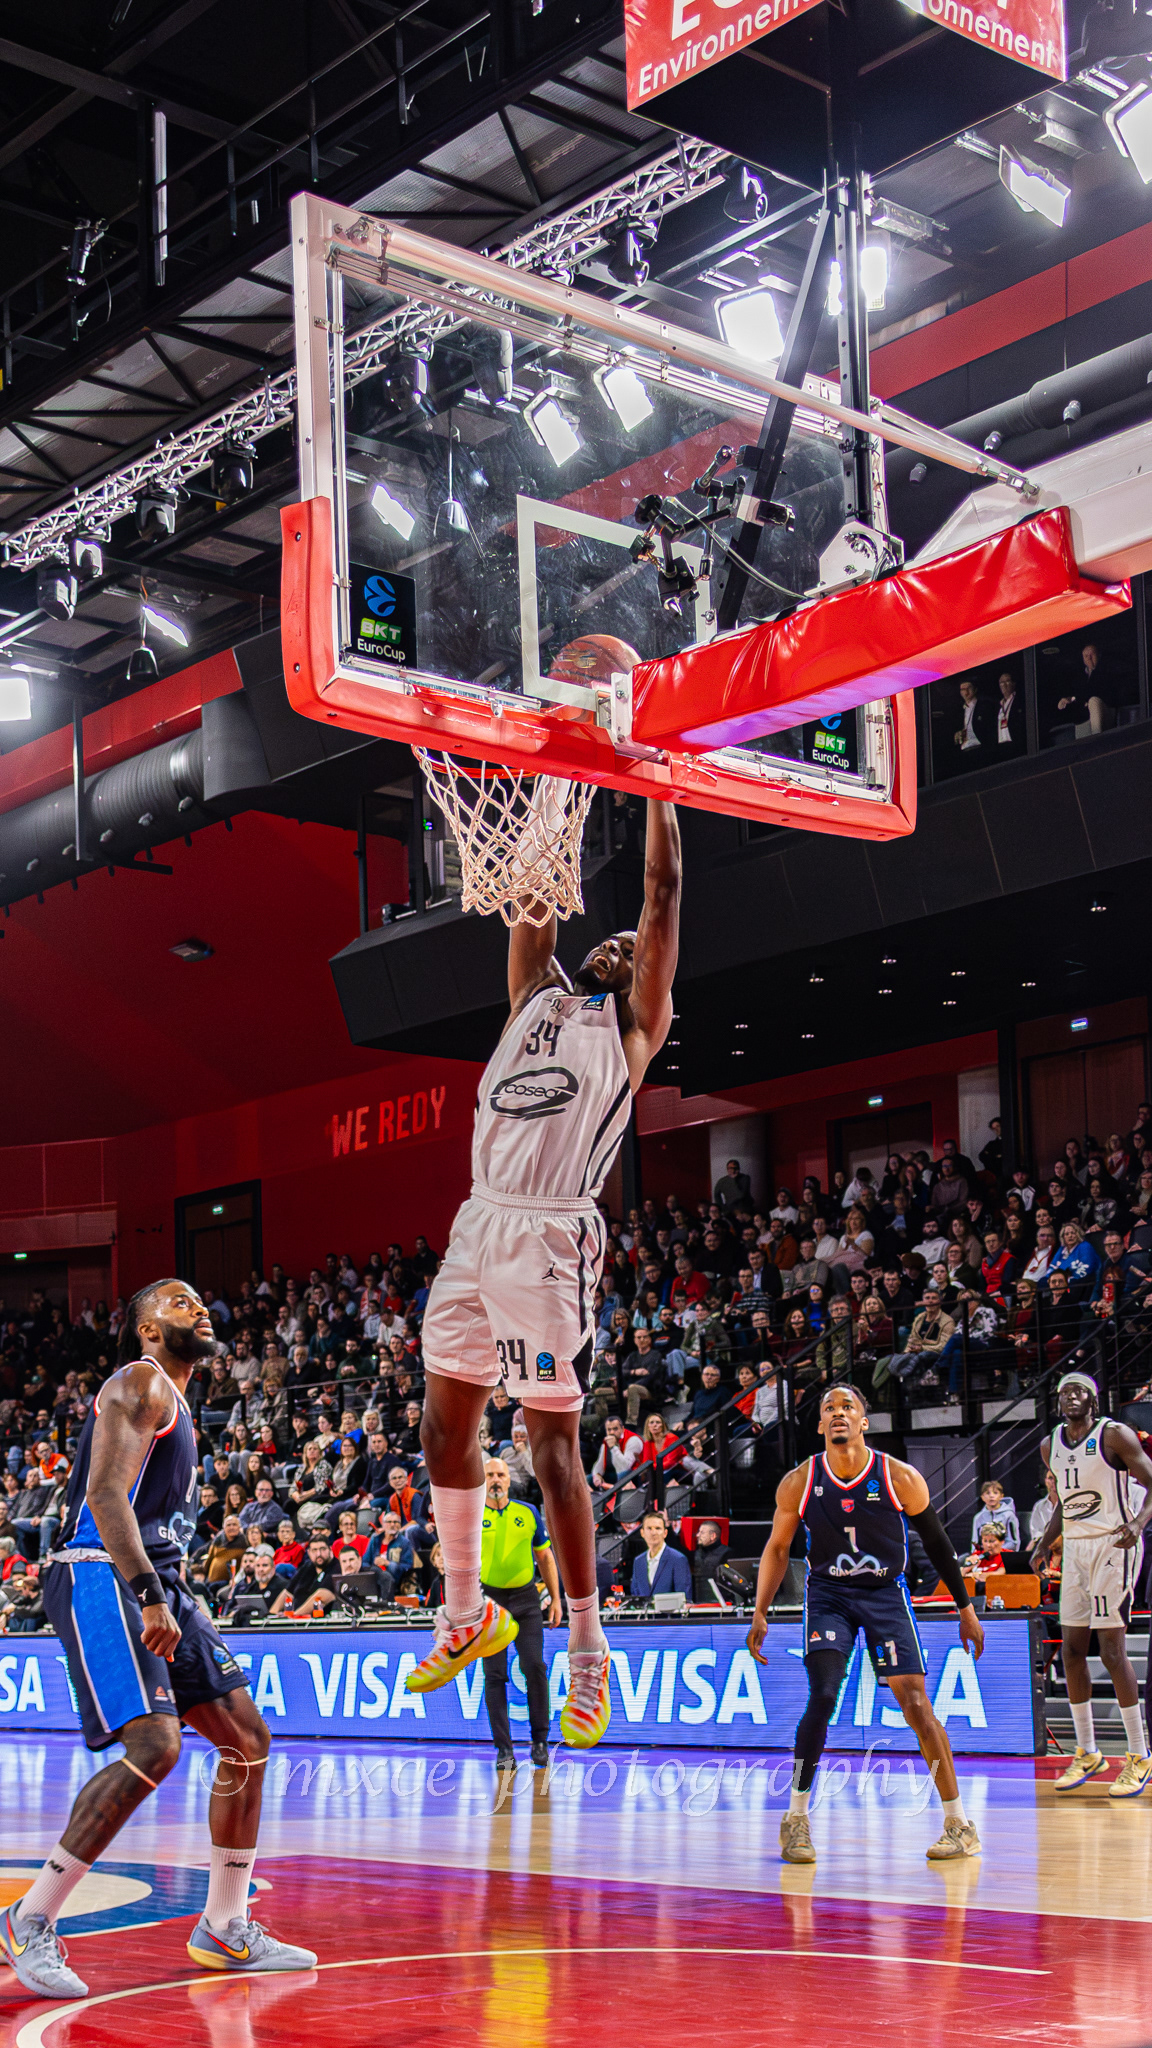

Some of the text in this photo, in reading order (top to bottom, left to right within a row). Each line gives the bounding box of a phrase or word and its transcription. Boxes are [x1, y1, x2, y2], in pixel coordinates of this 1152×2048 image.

[638, 0, 811, 98] Environnem
[360, 620, 401, 642] BKT
[357, 637, 406, 662] EuroCup
[815, 734, 846, 751] BKT
[812, 748, 850, 770] EuroCup
[525, 1018, 563, 1058] 34
[378, 1085, 446, 1145] REDY
[332, 1105, 370, 1158] WE
[496, 1338, 529, 1381] 34
[1064, 1467, 1081, 1490] 11
[1094, 1595, 1110, 1618] 11
[298, 1651, 427, 1719] VISA
[608, 1647, 769, 1725] VISA
